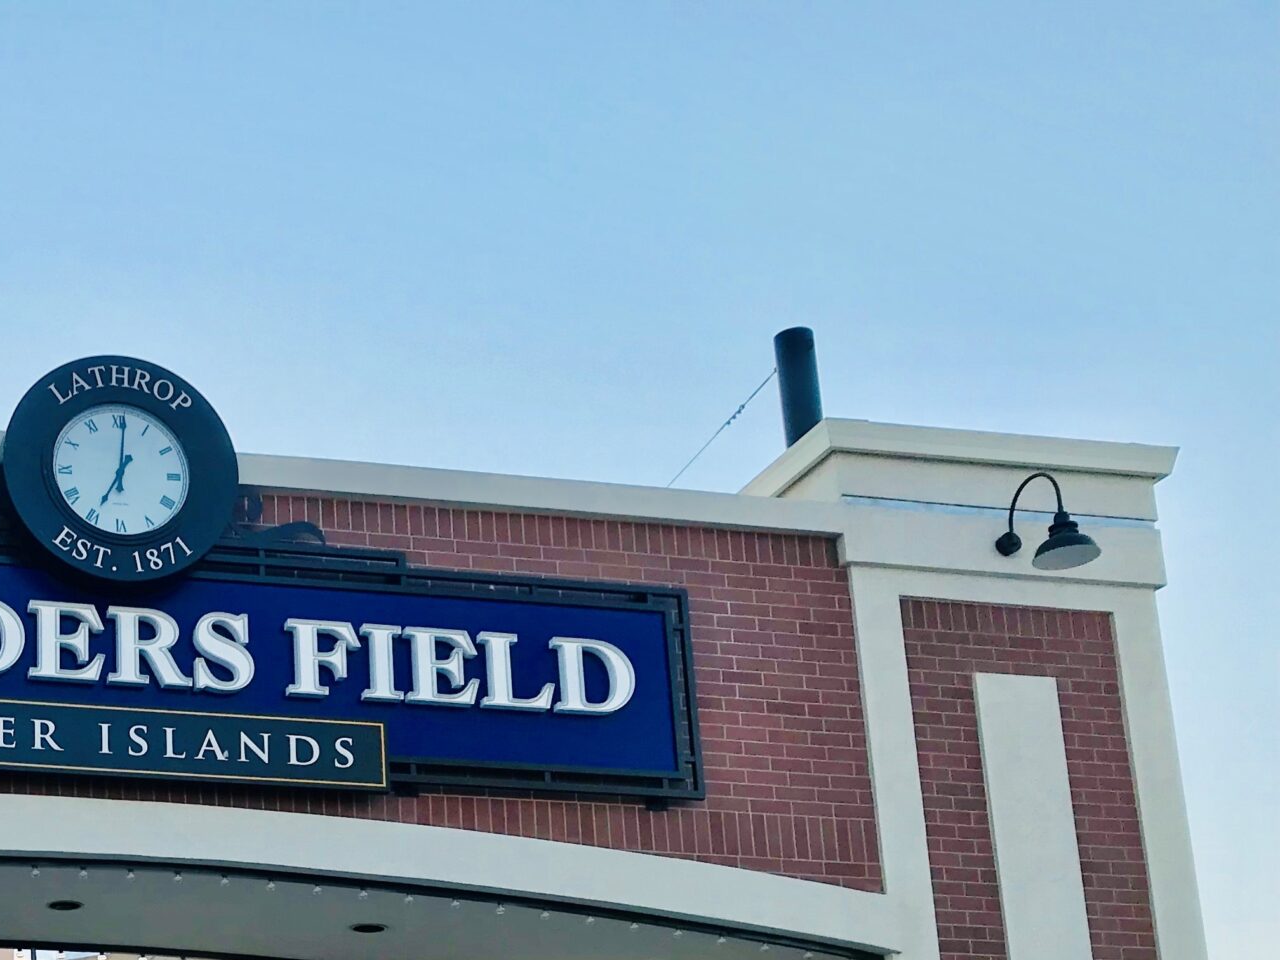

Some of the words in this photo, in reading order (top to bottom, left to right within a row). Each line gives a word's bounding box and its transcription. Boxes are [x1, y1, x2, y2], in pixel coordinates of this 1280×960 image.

[48, 365, 193, 411] LATHROP
[84, 418, 98, 434] XI
[64, 439, 80, 450] X
[115, 518, 127, 534] VI
[144, 516, 155, 529] V
[52, 526, 118, 572] EST.
[132, 536, 194, 573] 1871
[284, 616, 636, 716] FIELD
[98, 722, 356, 770] ISLANDS
